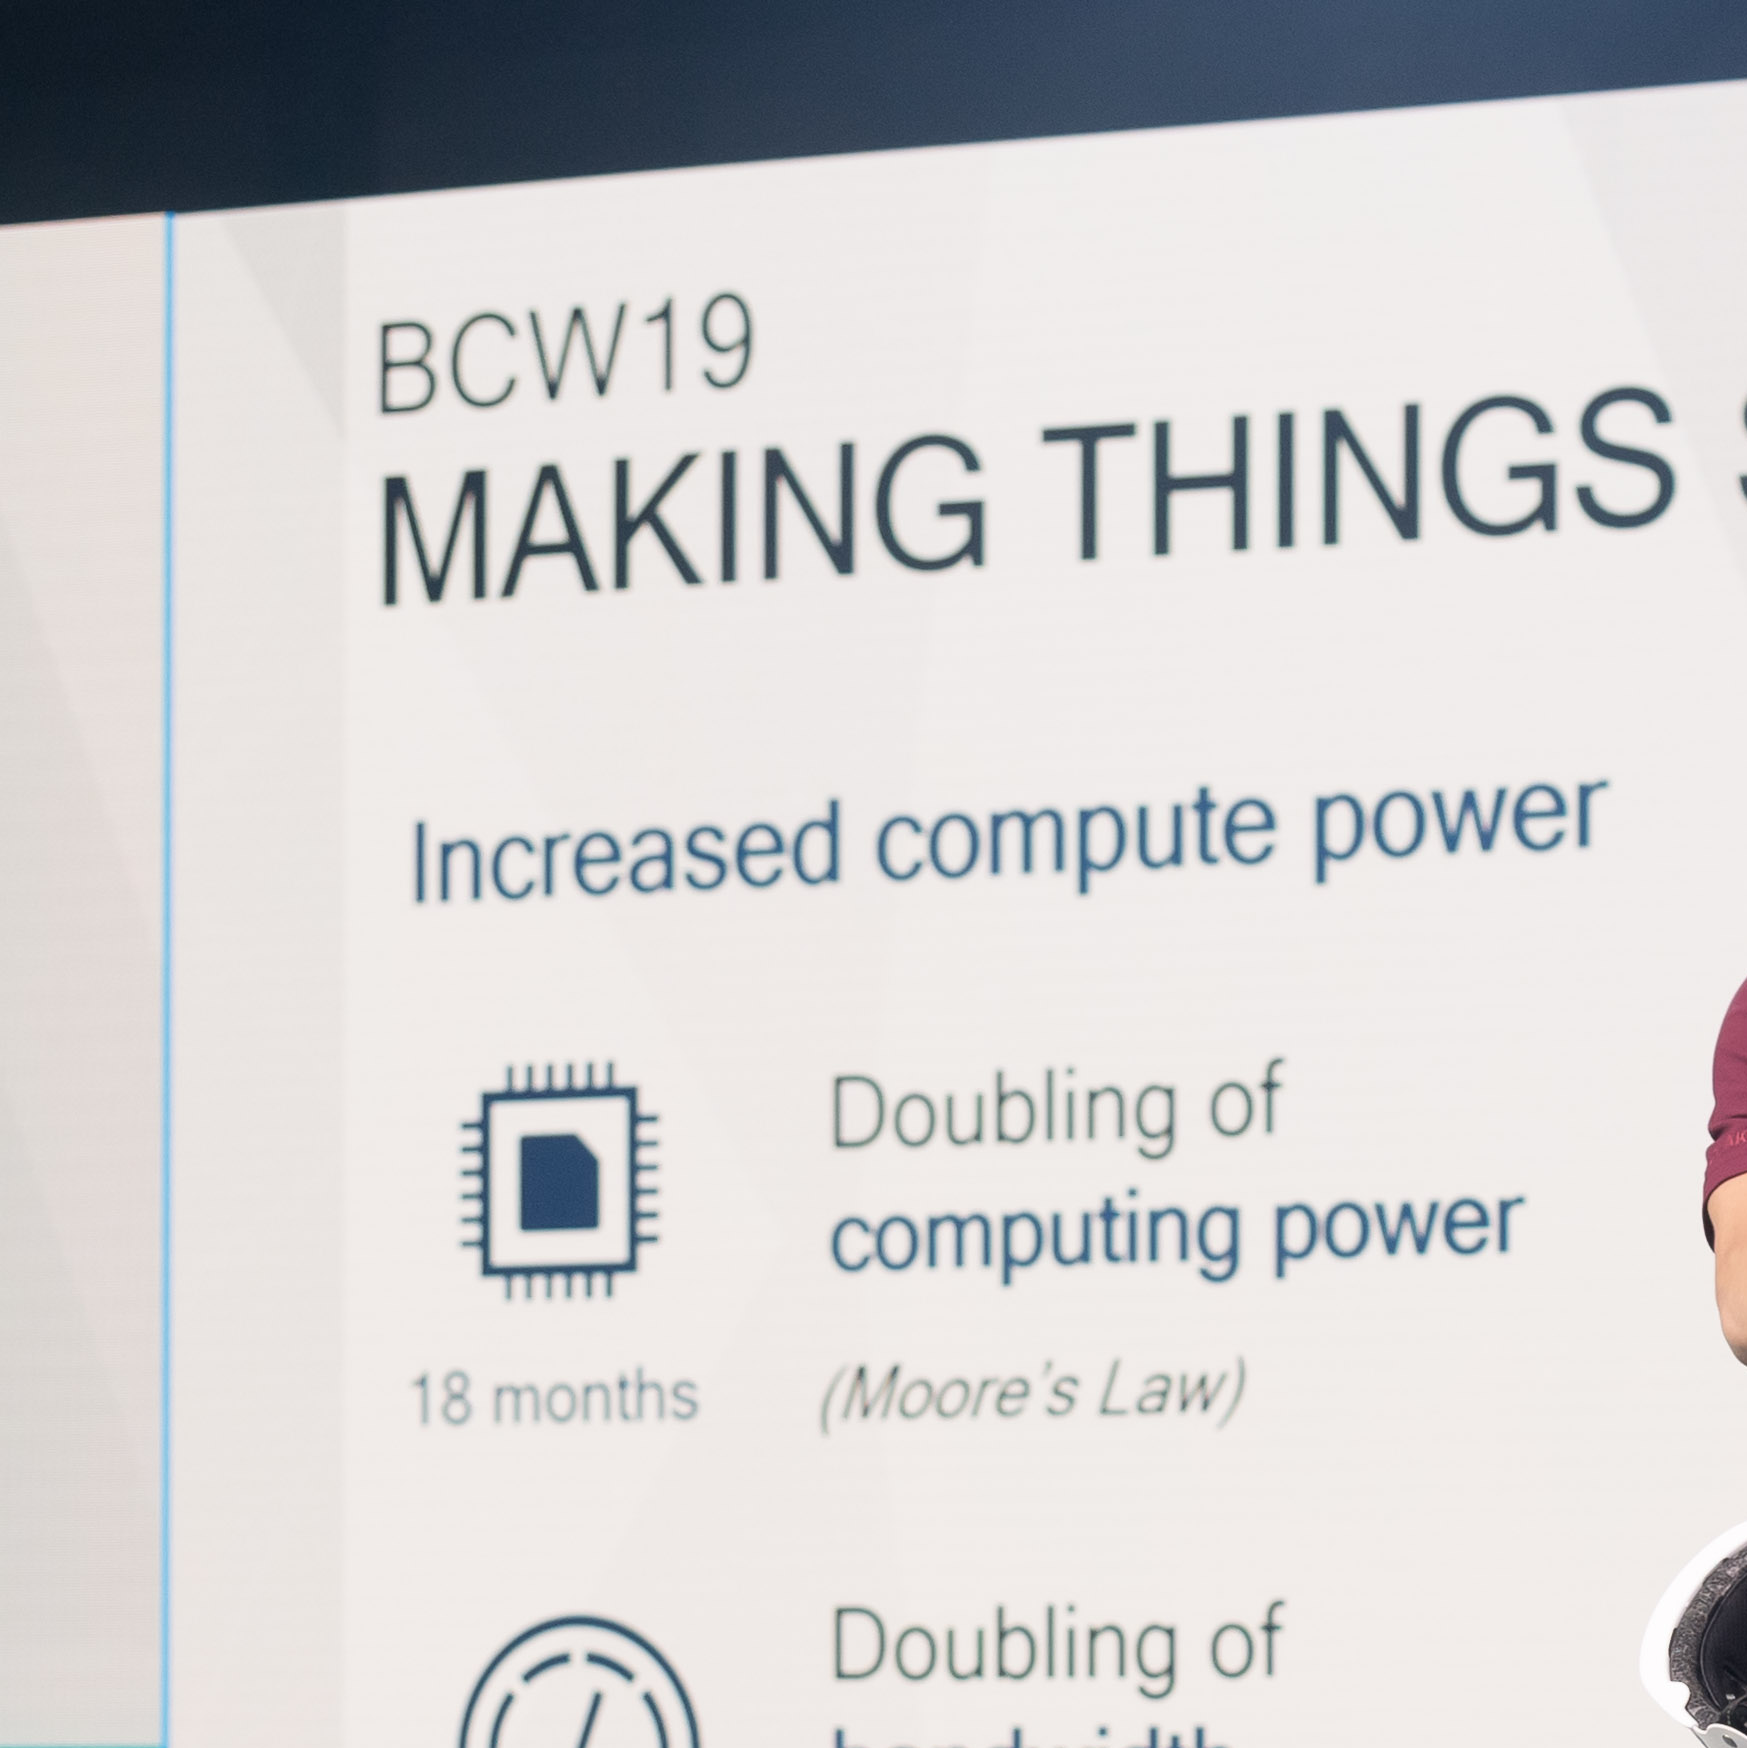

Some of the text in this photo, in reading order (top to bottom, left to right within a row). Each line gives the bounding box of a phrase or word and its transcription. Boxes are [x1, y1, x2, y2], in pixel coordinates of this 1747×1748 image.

[379, 291, 754, 416] BCW19
[383, 433, 985, 607] MAKING
[1041, 385, 1677, 561] THINGS
[415, 779, 1609, 904] Increased compute power
[832, 1056, 1285, 1161] Doubling of
[830, 1187, 1526, 1287] computing power
[412, 1366, 700, 1427] 18 months
[1098, 1357, 1246, 1430] Law)
[833, 1599, 1285, 1701] Doubling of
